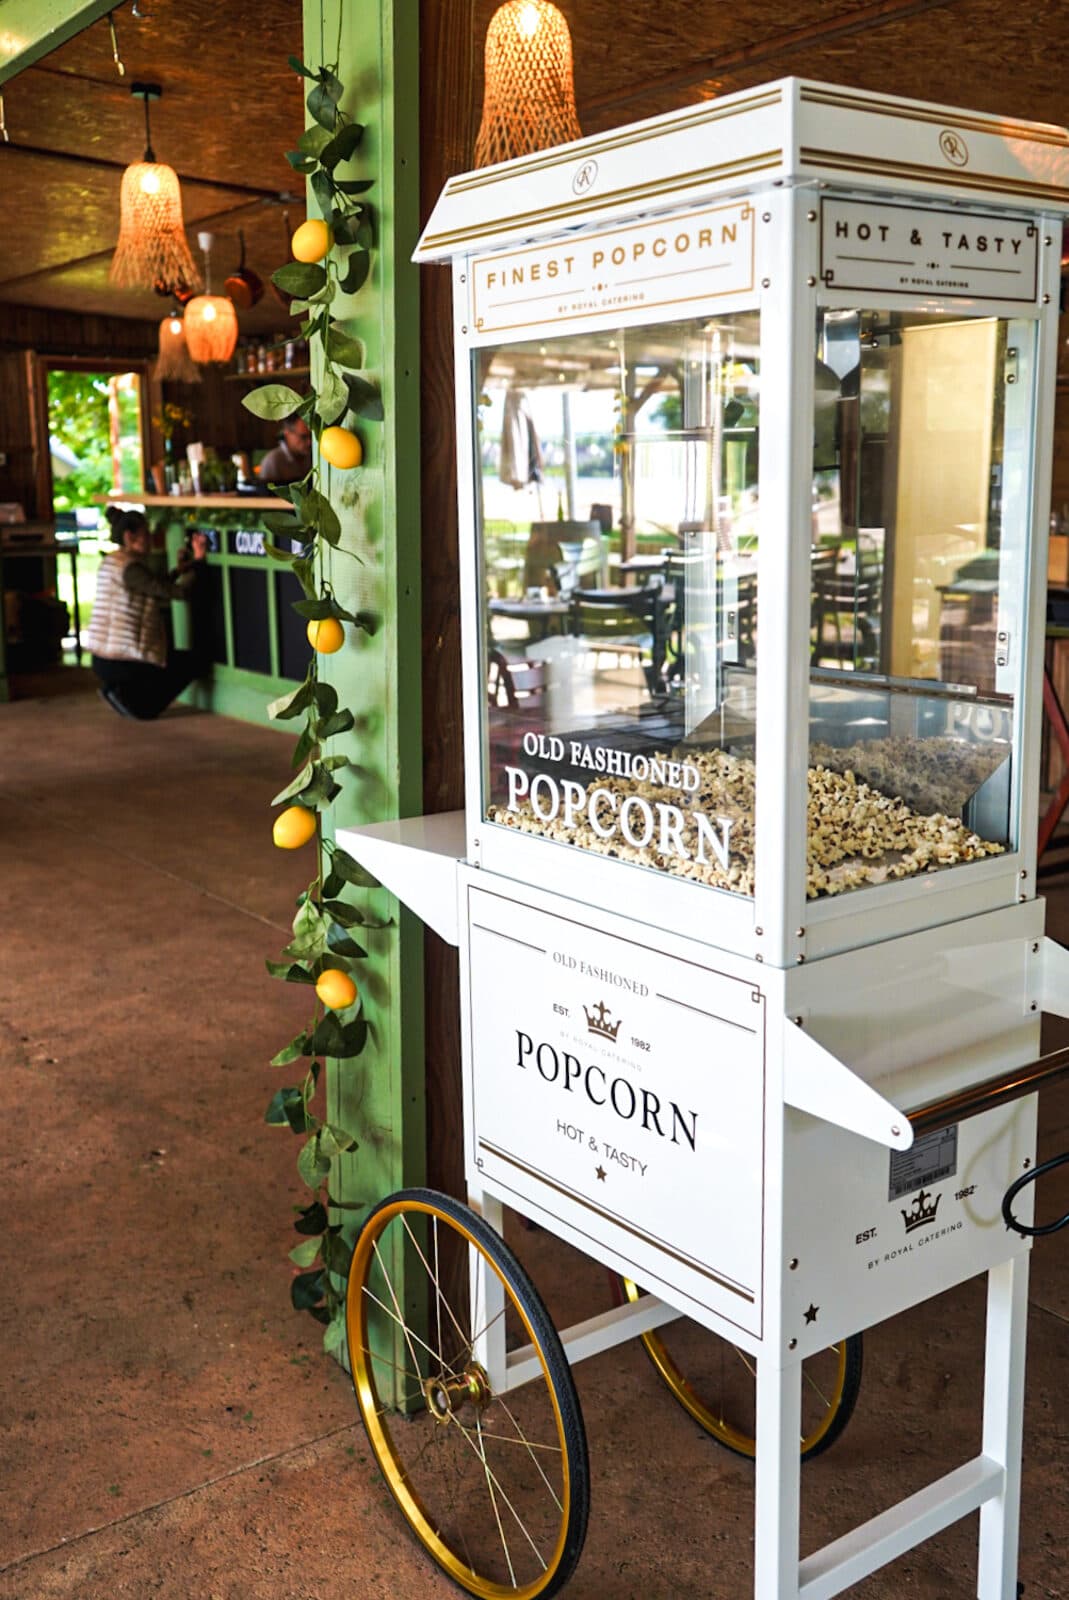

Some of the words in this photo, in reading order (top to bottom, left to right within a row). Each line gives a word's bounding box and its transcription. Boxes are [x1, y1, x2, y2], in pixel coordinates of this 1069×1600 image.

[487, 256, 575, 289] FINEST
[592, 223, 738, 269] POPCORN
[836, 221, 890, 242] HOT
[910, 229, 922, 246] &
[942, 232, 1022, 255] TASTY
[523, 732, 564, 762] OLD
[570, 741, 700, 792] FASHIONED
[505, 766, 734, 871] POPCORN
[552, 951, 577, 970] OLD
[580, 961, 649, 998] FASHIONED
[552, 1003, 570, 1018] EST.
[630, 1036, 651, 1052] 1982
[515, 1030, 699, 1152] POPCORN
[556, 1119, 584, 1144] HOT
[588, 1136, 598, 1152] &
[603, 1142, 648, 1177] TASTY
[855, 1227, 878, 1245] EST.
[955, 1185, 975, 1201] 1982
[867, 1259, 880, 1270] BY
[884, 1244, 914, 1262] ROYAL
[918, 1221, 964, 1247] CATERING
